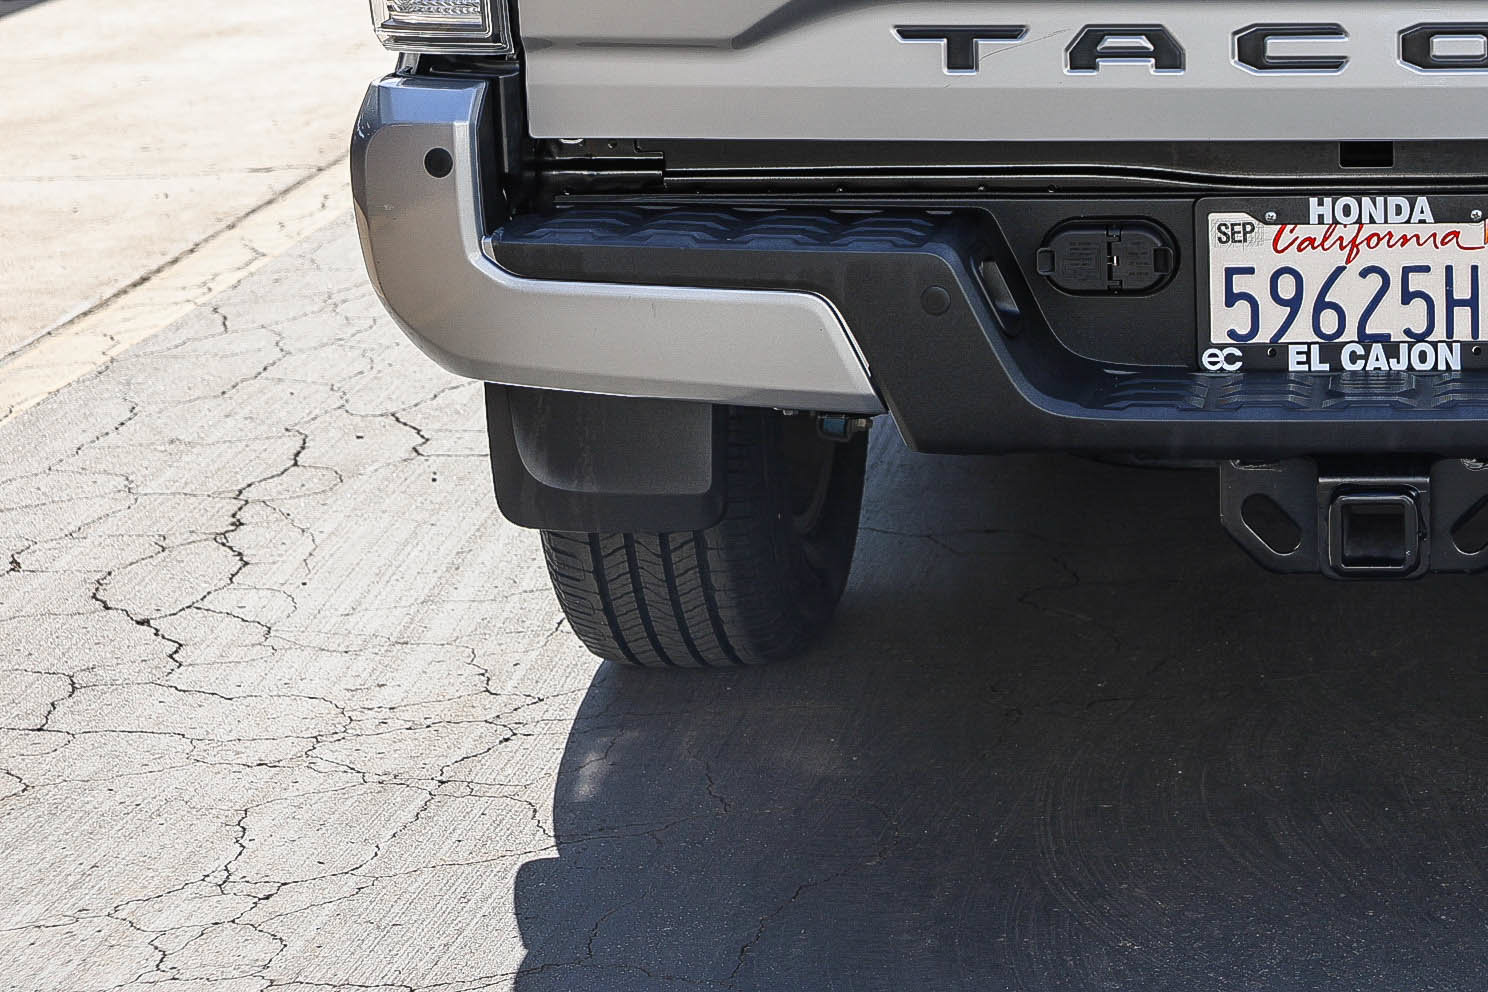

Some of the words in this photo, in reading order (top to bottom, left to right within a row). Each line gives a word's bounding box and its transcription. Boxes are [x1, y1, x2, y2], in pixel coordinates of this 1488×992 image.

[1309, 197, 1434, 224] HONDA
[1217, 221, 1255, 244] SEP
[1272, 224, 1485, 265] California
[1288, 344, 1329, 371] EL
[1341, 343, 1461, 370] CAJON
